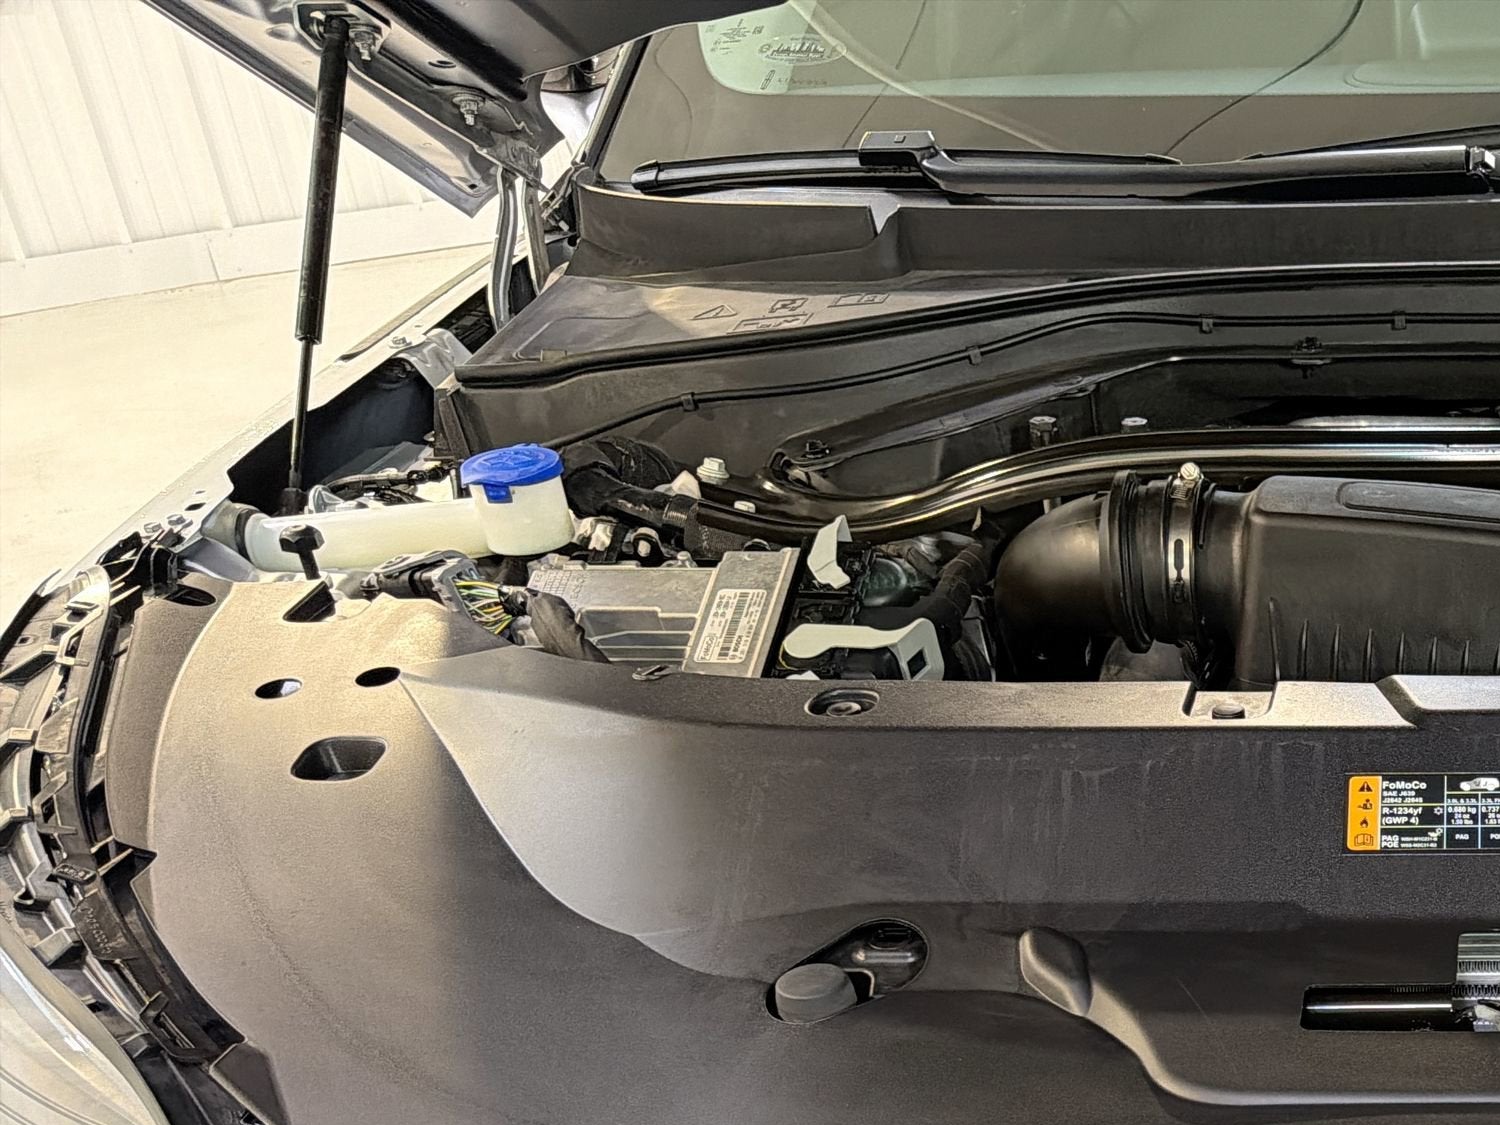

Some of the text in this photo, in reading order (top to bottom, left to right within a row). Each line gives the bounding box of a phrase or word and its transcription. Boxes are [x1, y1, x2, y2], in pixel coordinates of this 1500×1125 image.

[1382, 780, 1428, 790] FoMoCo
[1382, 806, 1423, 816] R-1234yf
[1467, 806, 1477, 814] kg
[1382, 816, 1419, 825] (GWP 4)
